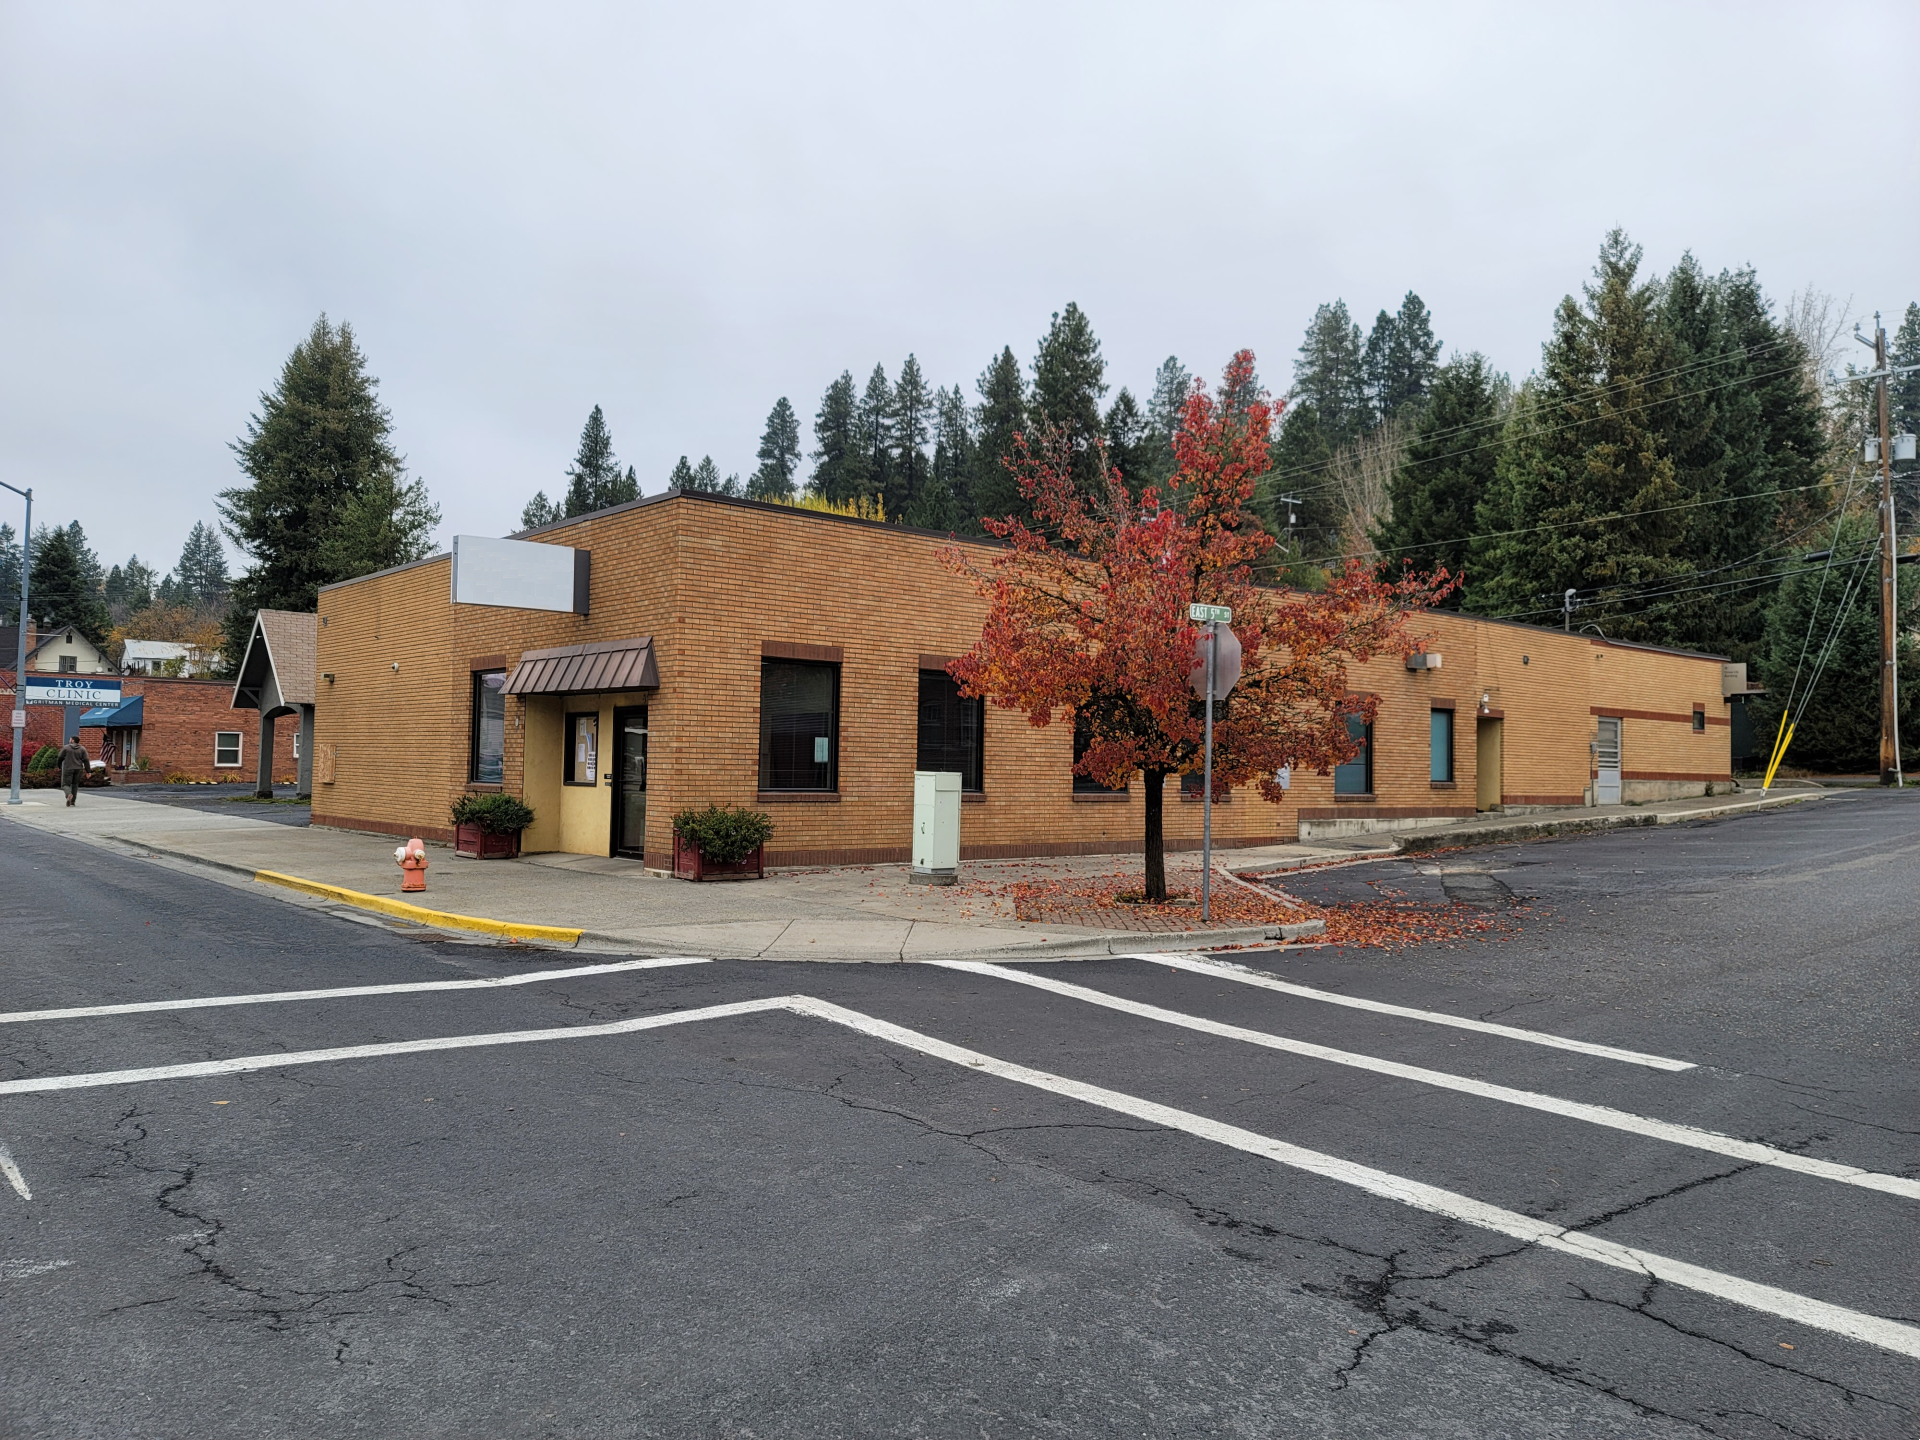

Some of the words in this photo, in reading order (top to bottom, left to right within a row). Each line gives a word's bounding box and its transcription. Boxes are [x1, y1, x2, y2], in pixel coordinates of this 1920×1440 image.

[1192, 606, 1208, 618] EAST
[1210, 608, 1220, 620] 5TH
[56, 680, 94, 688] TROY
[46, 688, 102, 700] CLINIC
